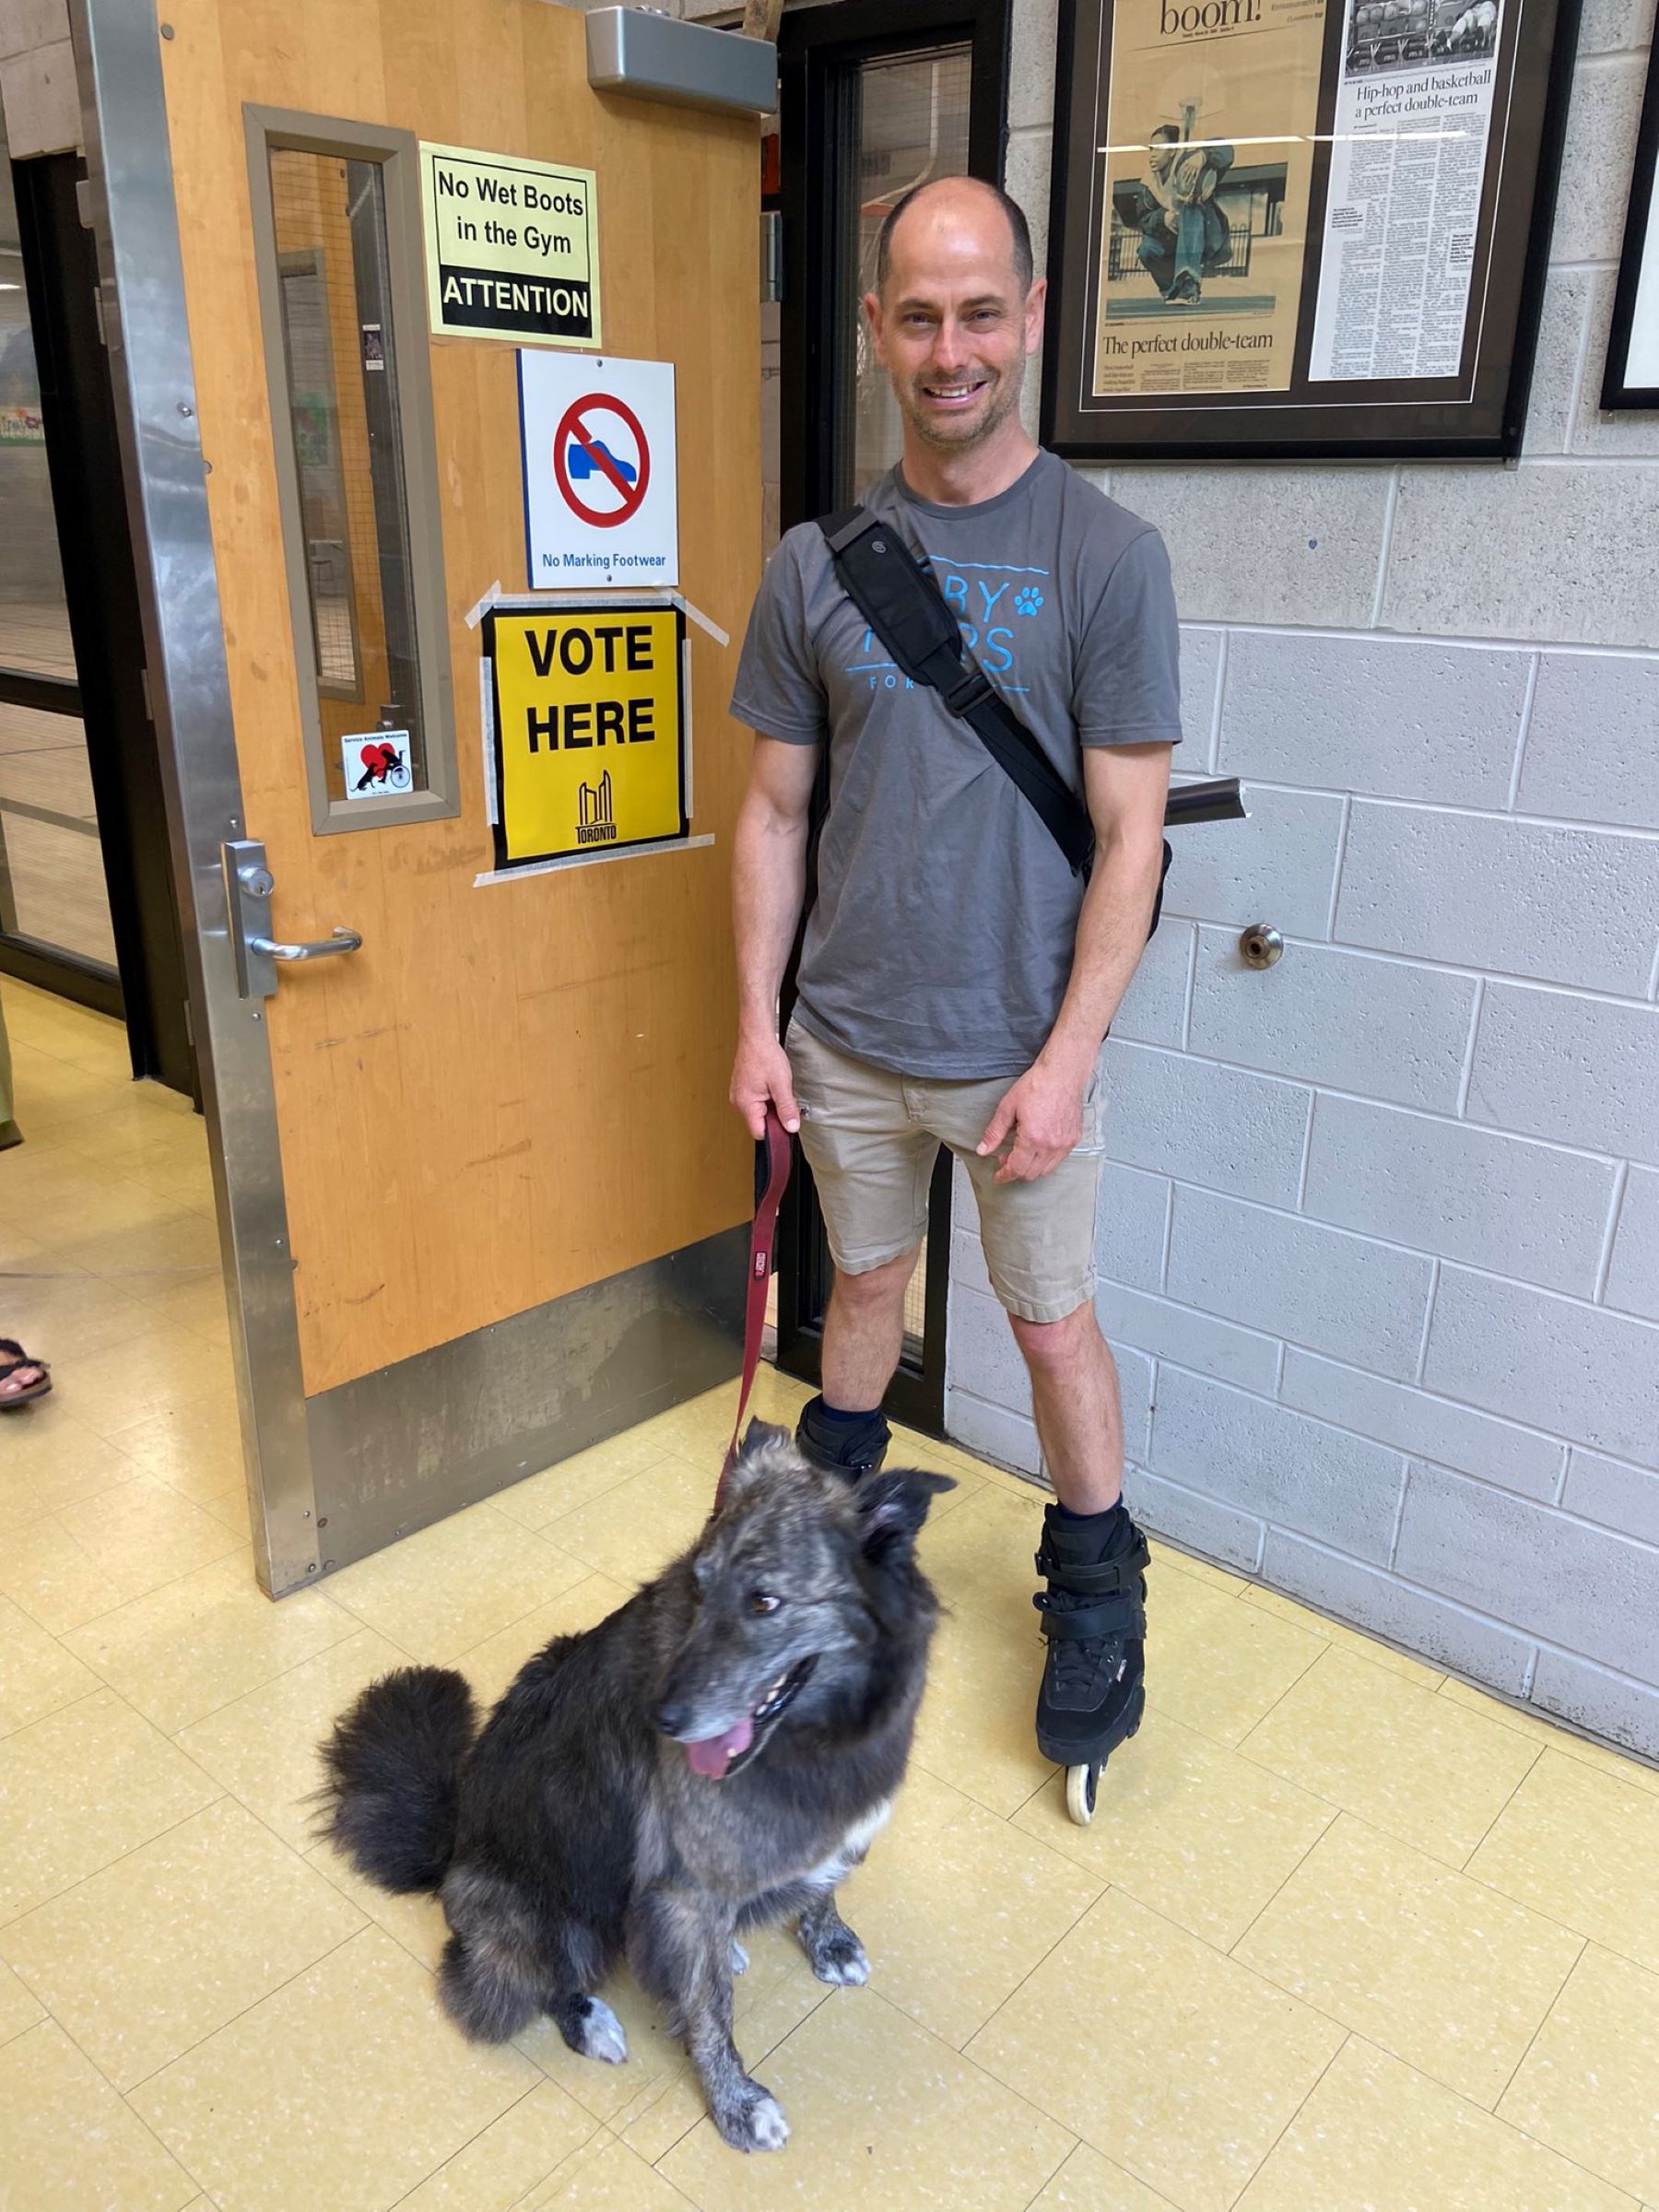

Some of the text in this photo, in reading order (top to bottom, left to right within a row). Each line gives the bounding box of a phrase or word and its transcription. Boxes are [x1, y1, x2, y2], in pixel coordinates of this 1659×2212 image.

[1160, 0, 1261, 34] boom!
[1357, 84, 1404, 103] Hip-hop
[1406, 77, 1429, 94] and
[1431, 69, 1491, 90] basketball
[1355, 93, 1478, 121] a perfect double-team
[438, 171, 583, 216] No Wet Boots
[457, 216, 571, 256] in the Gym
[442, 276, 589, 318] ATTENTION
[1102, 331, 1273, 359] The perfect double-team
[543, 554, 666, 570] No Marking Footwear
[524, 625, 653, 677] VOTE
[527, 698, 654, 753] HERE
[575, 822, 617, 844] TORONTO
